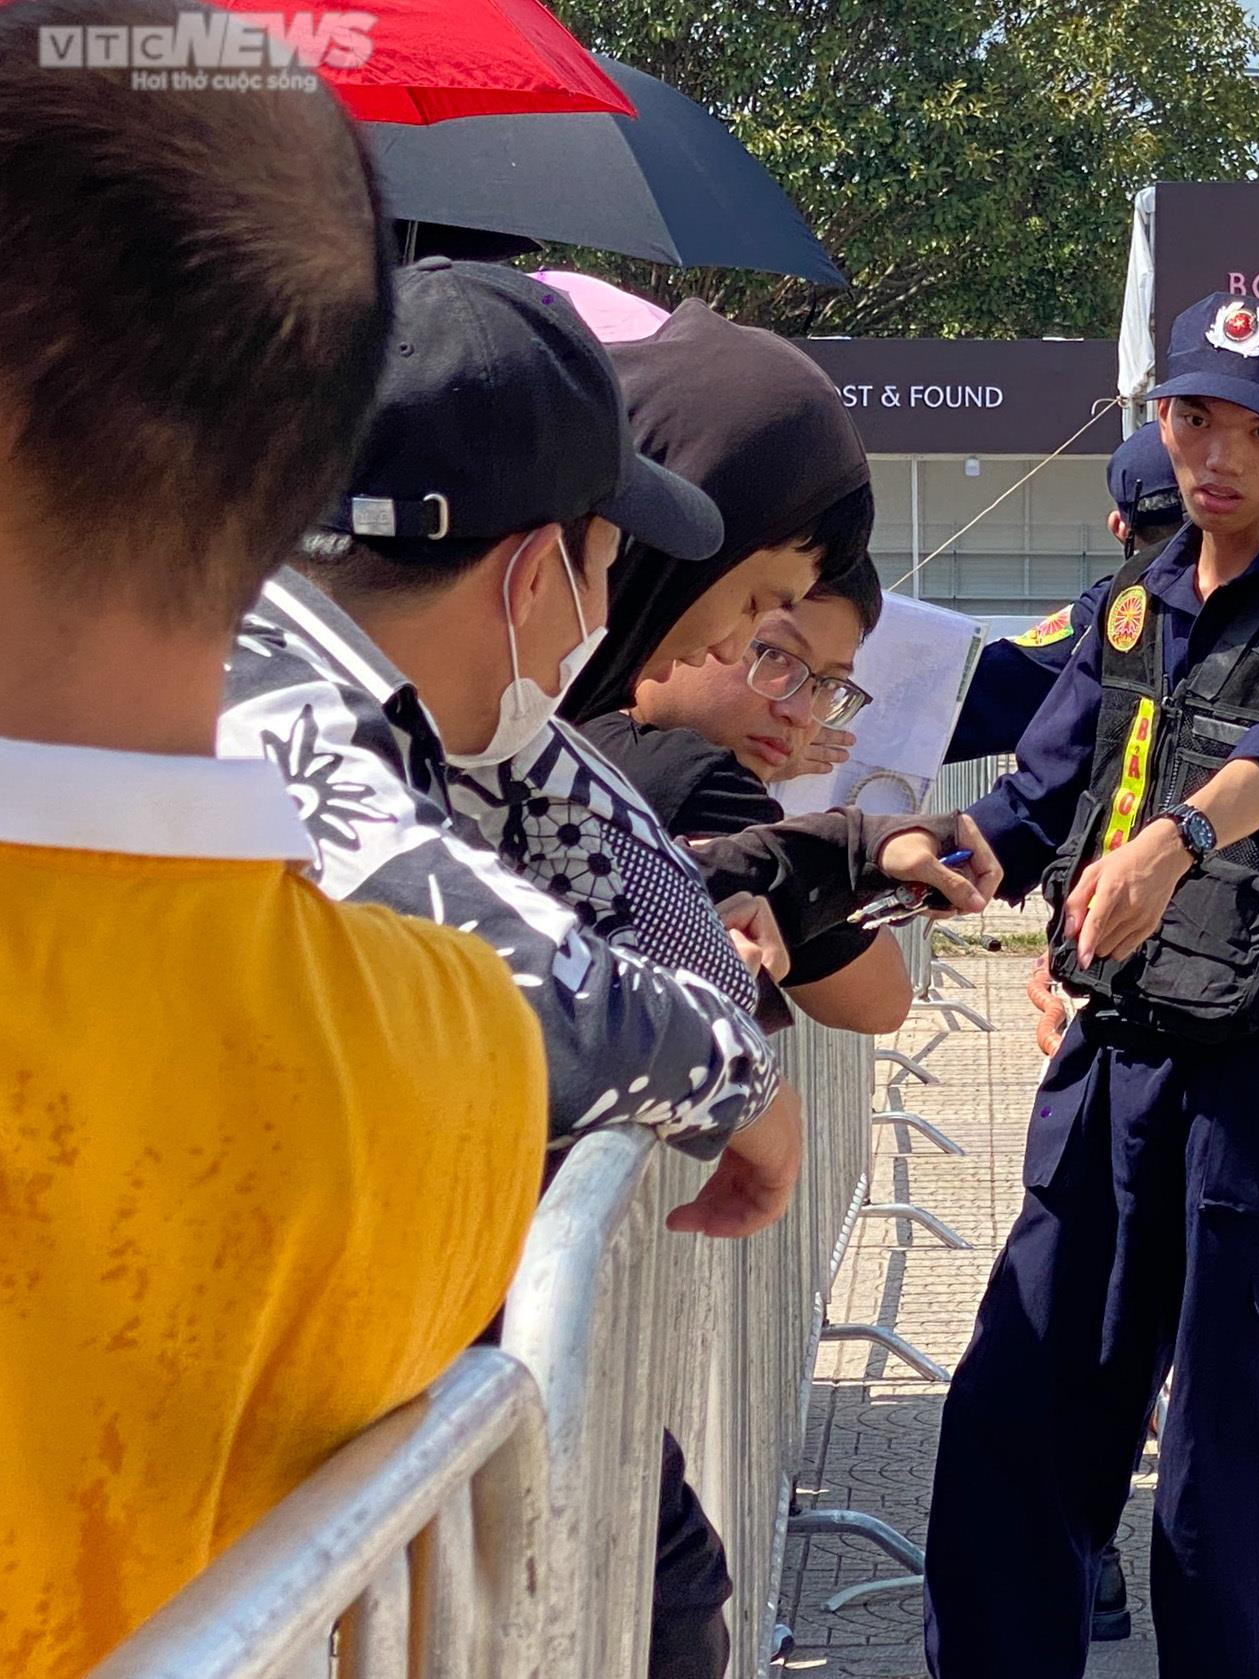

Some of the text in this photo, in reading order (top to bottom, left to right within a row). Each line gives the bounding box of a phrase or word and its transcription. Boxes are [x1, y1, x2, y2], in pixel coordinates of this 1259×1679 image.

[834, 384, 1004, 408] ST & FOUND
